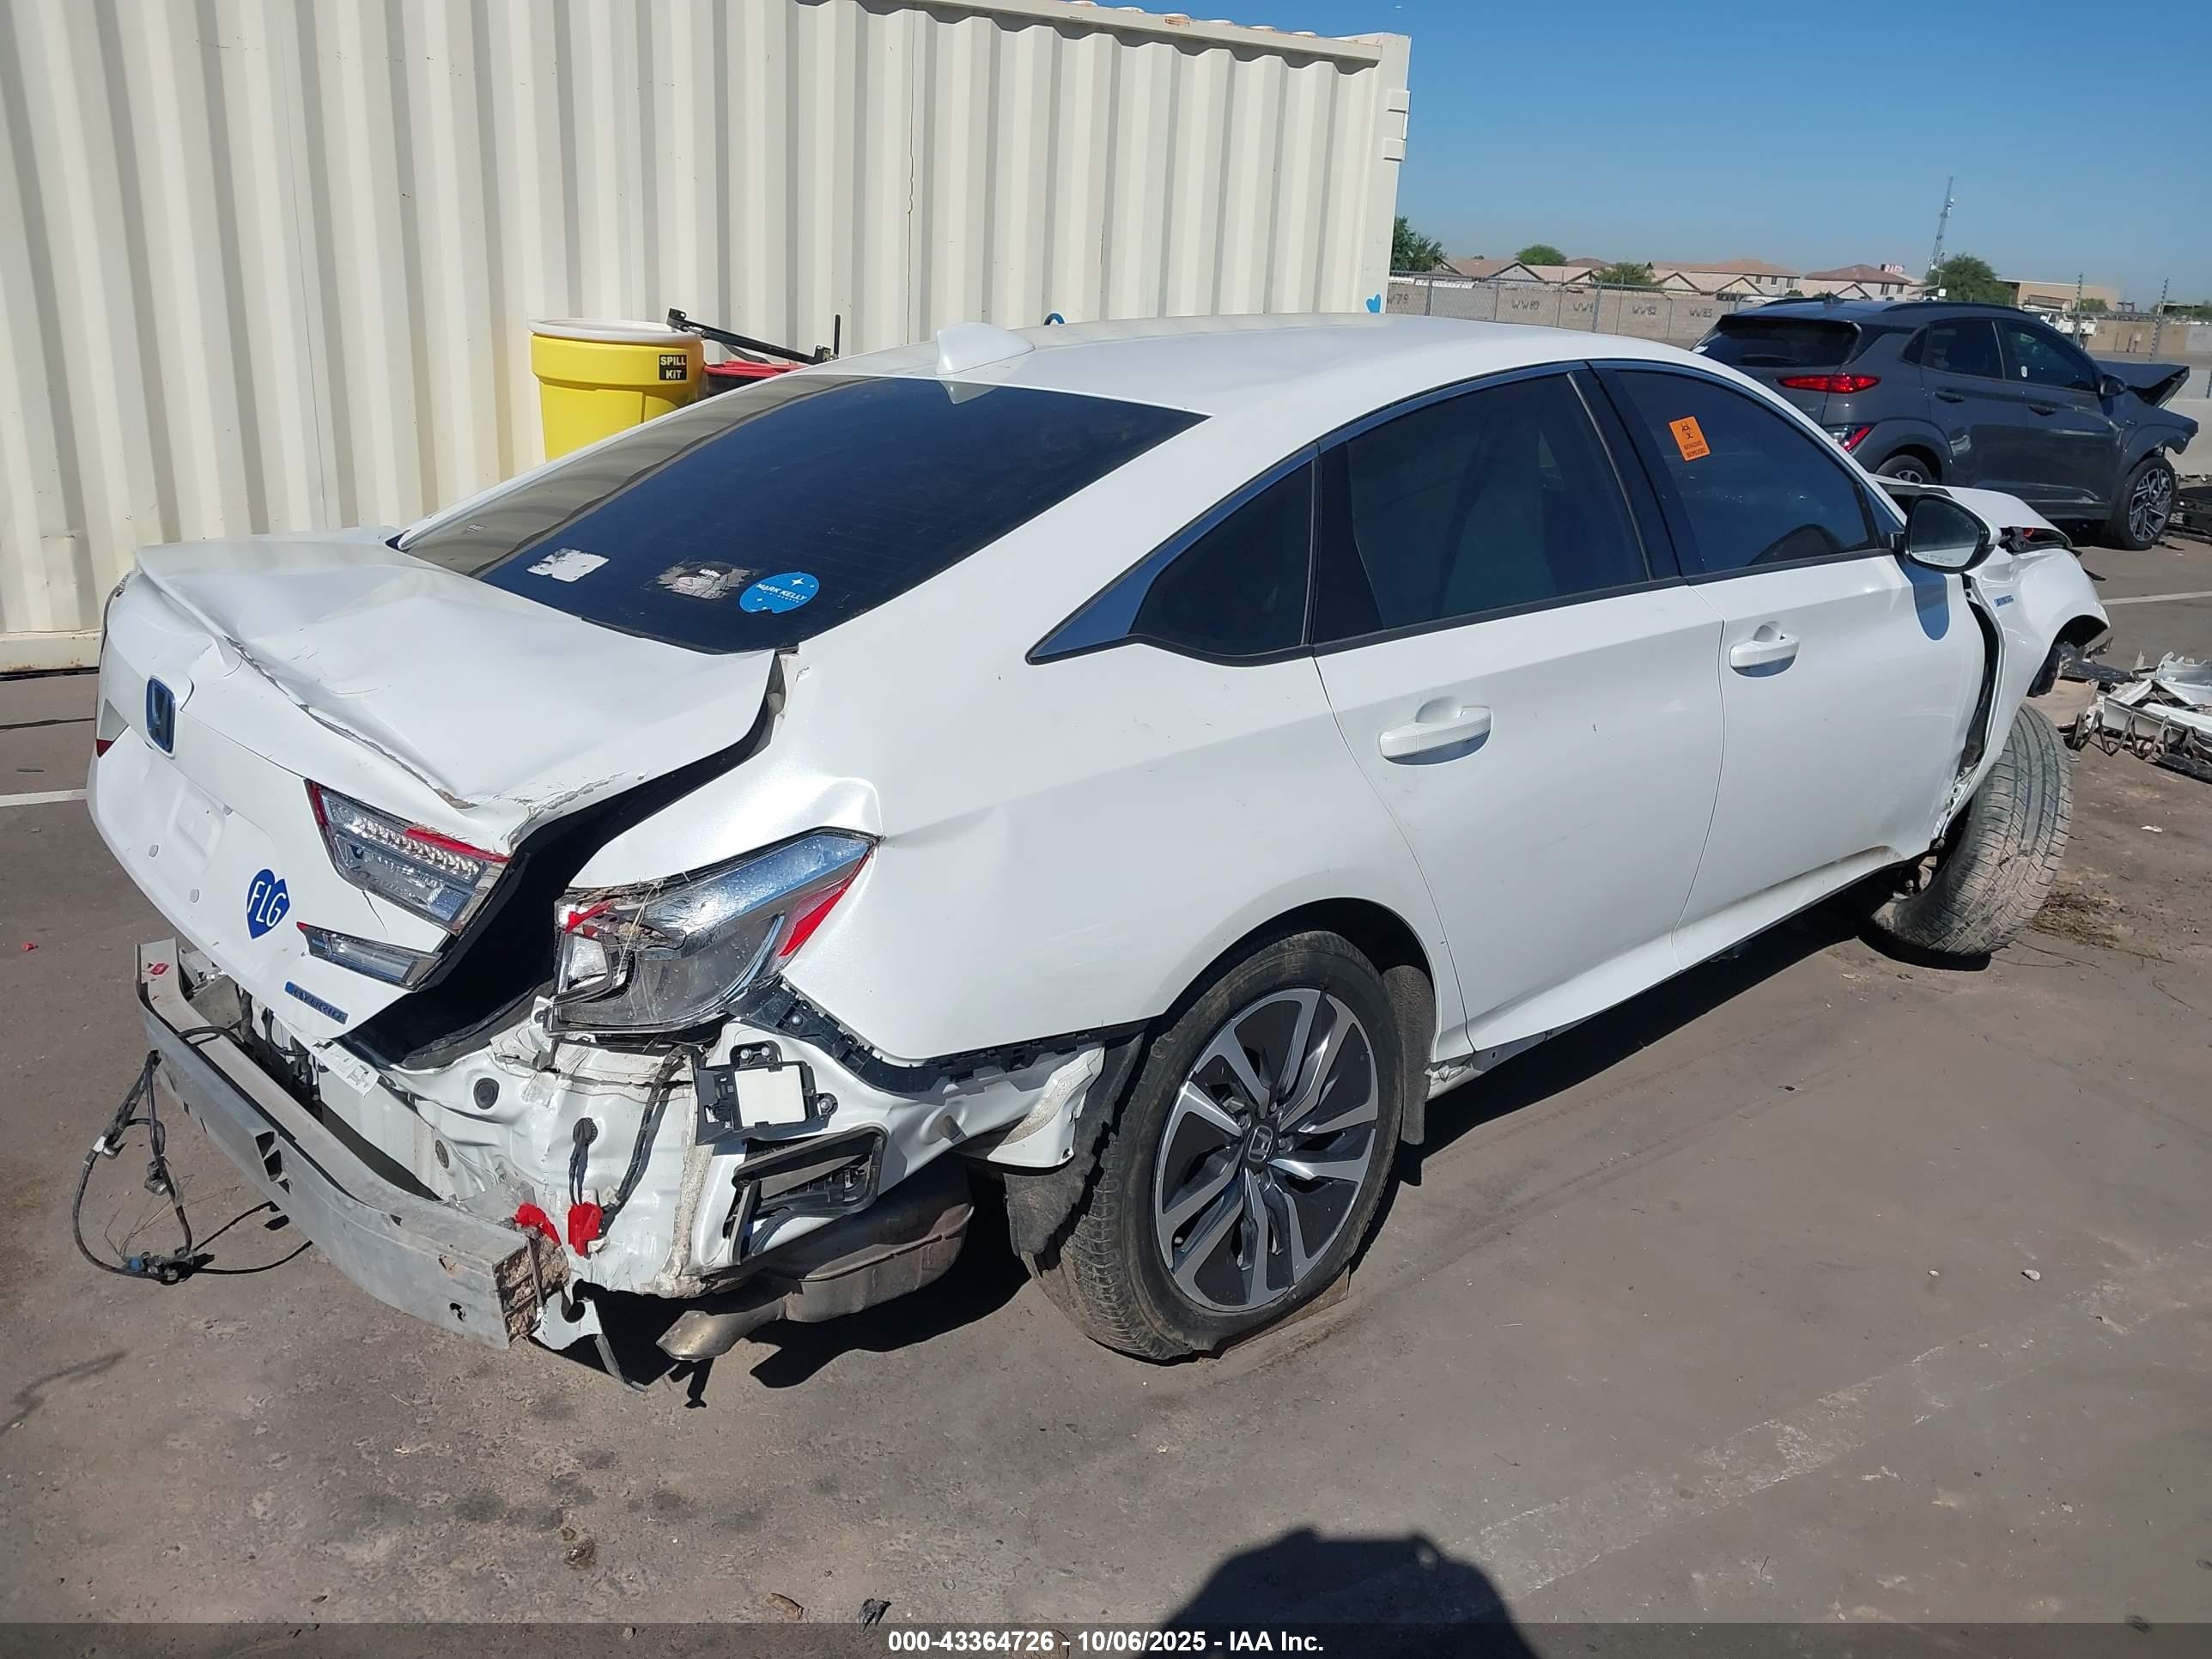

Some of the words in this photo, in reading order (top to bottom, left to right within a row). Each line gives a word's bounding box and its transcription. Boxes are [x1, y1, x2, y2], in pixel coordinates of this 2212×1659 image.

[1572, 302, 1595, 313] WW8
[659, 356, 686, 366] SPILL
[665, 369, 683, 380] KIT
[755, 583, 780, 594] MARK
[779, 590, 808, 601] KELLY
[247, 880, 287, 927] FLG
